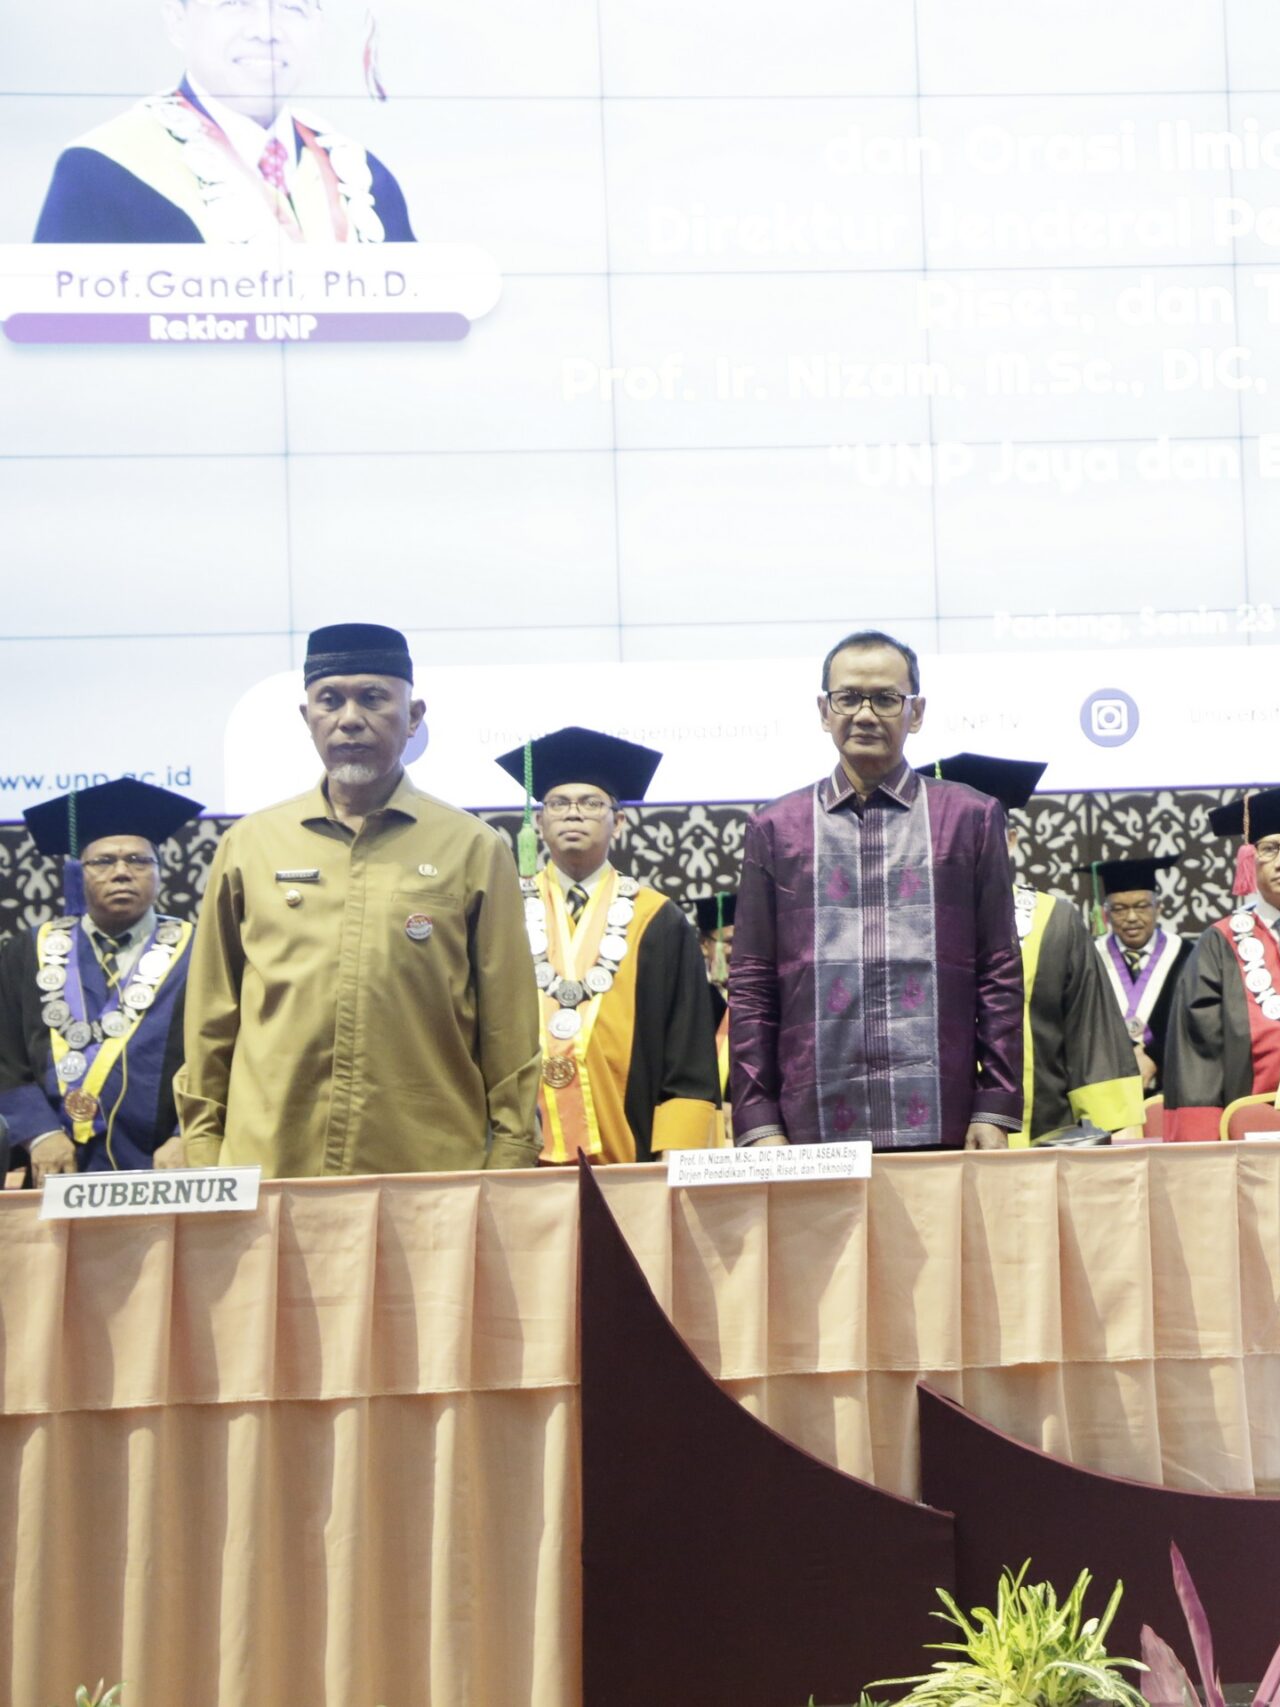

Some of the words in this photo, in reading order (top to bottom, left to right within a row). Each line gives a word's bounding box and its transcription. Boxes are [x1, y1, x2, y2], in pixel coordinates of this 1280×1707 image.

[823, 123, 943, 176] dan
[967, 121, 1136, 175] Orasi
[647, 202, 907, 257] Direktur
[929, 197, 1191, 251] Jenderal
[323, 270, 419, 299] Ph.D.
[919, 279, 1096, 331] Riset,
[1116, 275, 1234, 327] dan
[150, 315, 247, 340] Rektor
[255, 315, 317, 340] UNP
[561, 352, 696, 400] Prof.
[715, 354, 768, 400] Ir.
[788, 352, 967, 398] Nizam,
[985, 349, 1144, 397] M.Sc.,
[1162, 346, 1268, 394] DIC,
[990, 441, 1119, 494] Jaya
[1136, 434, 1239, 482] dan
[992, 608, 1131, 643] Padang,
[1139, 605, 1228, 637] Senin
[1235, 602, 1276, 633] 23
[63, 1178, 238, 1209] GUBERNUR
[679, 1169, 702, 1183] Dirjen
[704, 1167, 746, 1179] Pendidikan
[801, 1163, 815, 1175] dan
[818, 1161, 855, 1176] Teknologi
